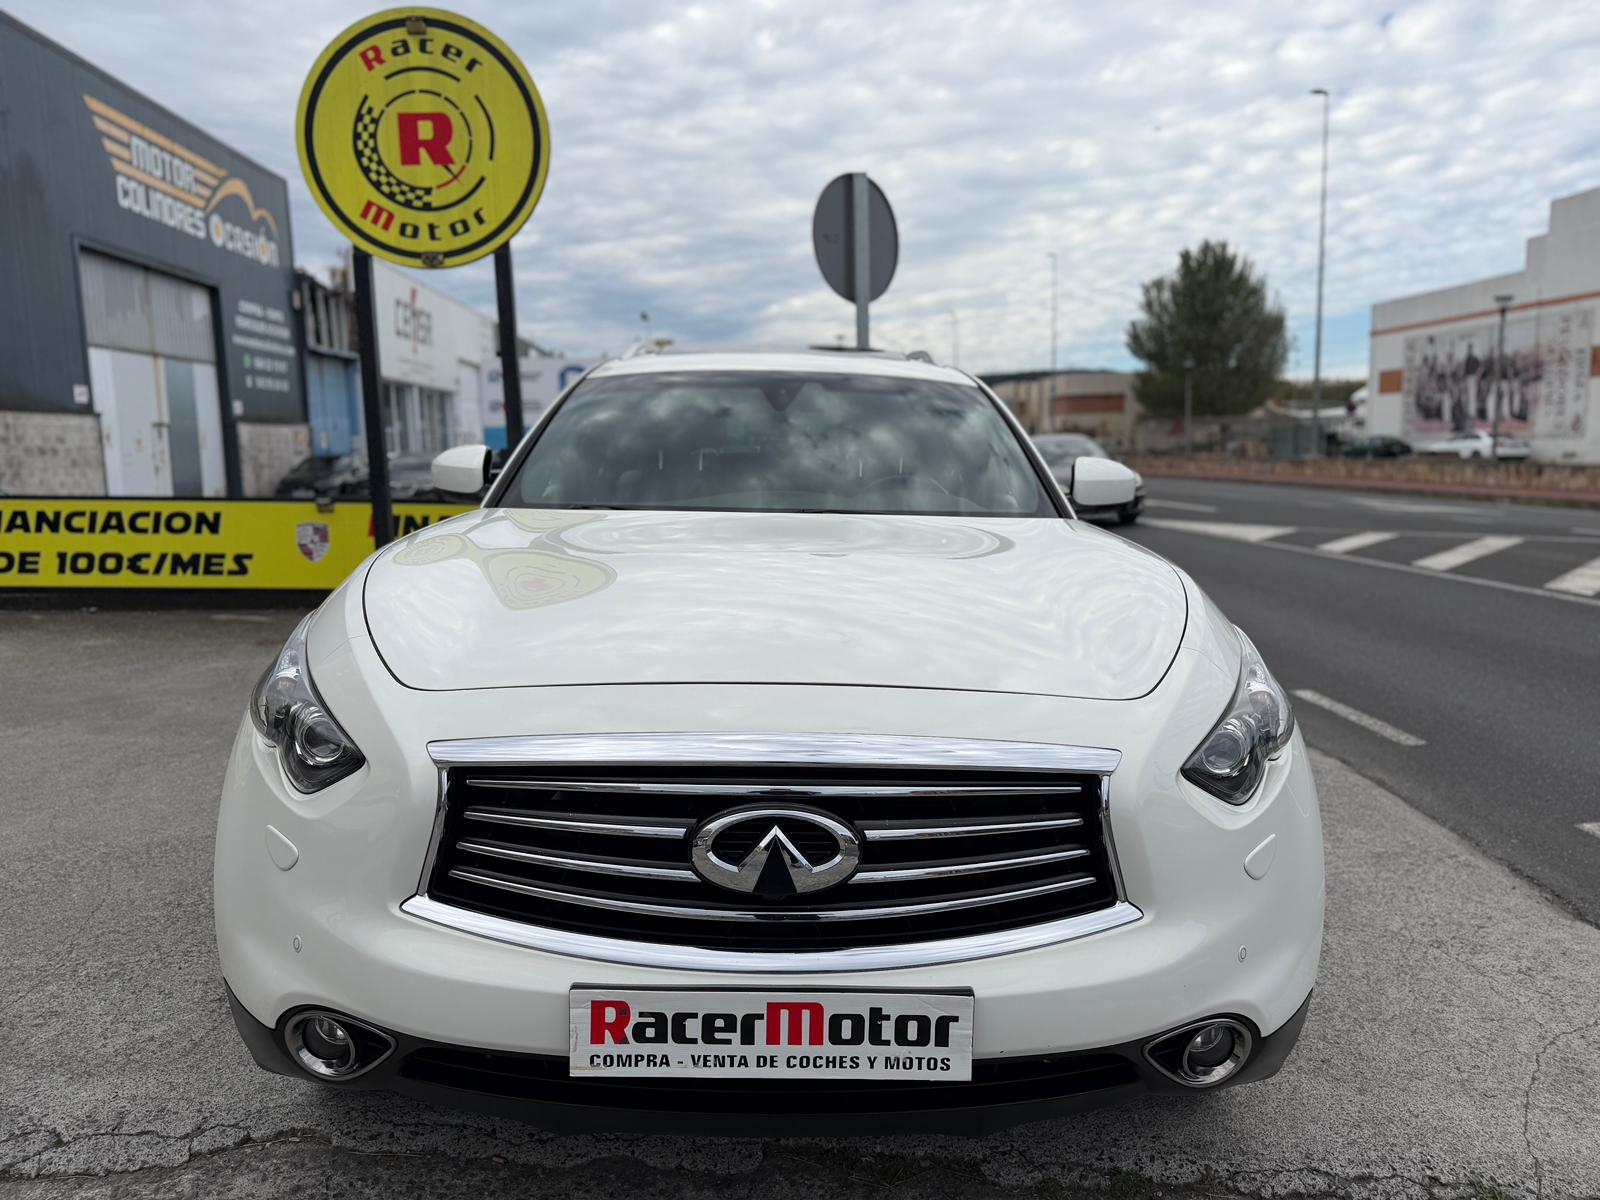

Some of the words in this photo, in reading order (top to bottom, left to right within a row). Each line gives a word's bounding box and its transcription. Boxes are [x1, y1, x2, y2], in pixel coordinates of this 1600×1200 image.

[359, 37, 483, 72] Racer
[397, 112, 456, 166] R
[130, 134, 198, 194] MOTOR
[116, 173, 207, 240] COLINDRES
[359, 200, 487, 241] Motor
[0, 511, 221, 535] ANCIACION
[57, 552, 253, 576] 100€/MES
[590, 1000, 959, 1048] RacerMotor
[589, 1054, 671, 1068] COMPRA
[691, 1054, 749, 1068] VENTA
[756, 1055, 778, 1069] DE
[786, 1055, 860, 1070] COCHES
[867, 1056, 878, 1070] Y
[884, 1056, 951, 1072] MOTOS
